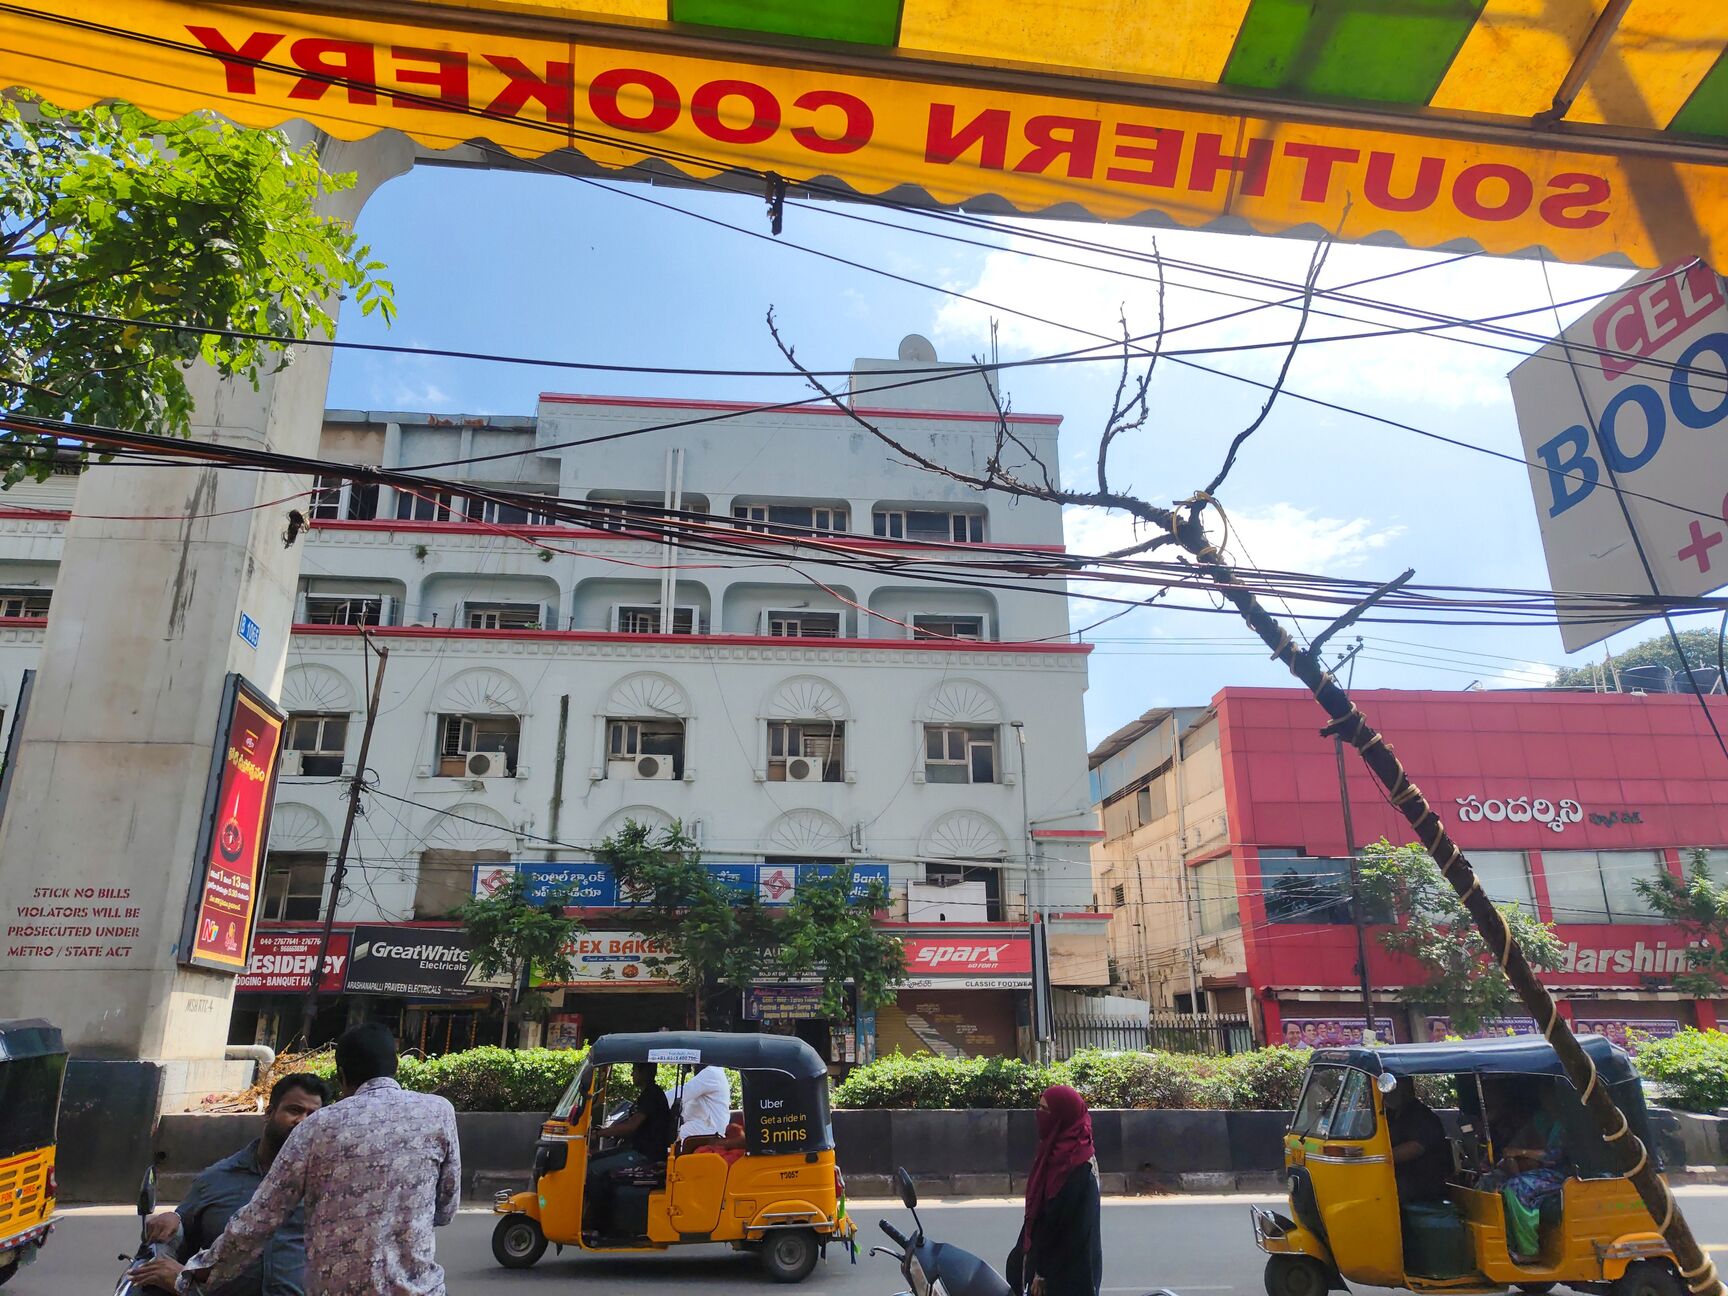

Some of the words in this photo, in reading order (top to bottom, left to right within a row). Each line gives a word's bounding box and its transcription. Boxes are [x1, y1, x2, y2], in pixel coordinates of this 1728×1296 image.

[1606, 264, 1722, 362] CEL
[853, 872, 886, 884] Bank
[33, 888, 70, 898] STICK
[74, 888, 95, 899] NO
[98, 888, 131, 899] BILLS
[17, 907, 89, 918] VIOLATORS
[92, 907, 121, 918] WILL
[124, 907, 141, 918] BE
[7, 926, 92, 937] PROSECUTED
[95, 926, 140, 937] UNDER
[7, 946, 54, 957] METRO
[65, 946, 103, 957] STATE
[105, 946, 133, 957] ACT
[372, 941, 470, 963] GreatWhite
[915, 943, 1010, 967] sparx
[247, 954, 346, 975] ESIDENCY
[420, 960, 467, 972] Electricals
[266, 976, 300, 988] BANQUET
[384, 982, 408, 993] PRAVEEN
[408, 984, 442, 995] ELECTRICALS
[760, 1099, 784, 1109] Uber
[760, 1116, 776, 1125] Get
[783, 1113, 799, 1123] ride
[800, 1113, 807, 1121] in
[760, 1128, 770, 1143] 3
[773, 1127, 807, 1143] mins
